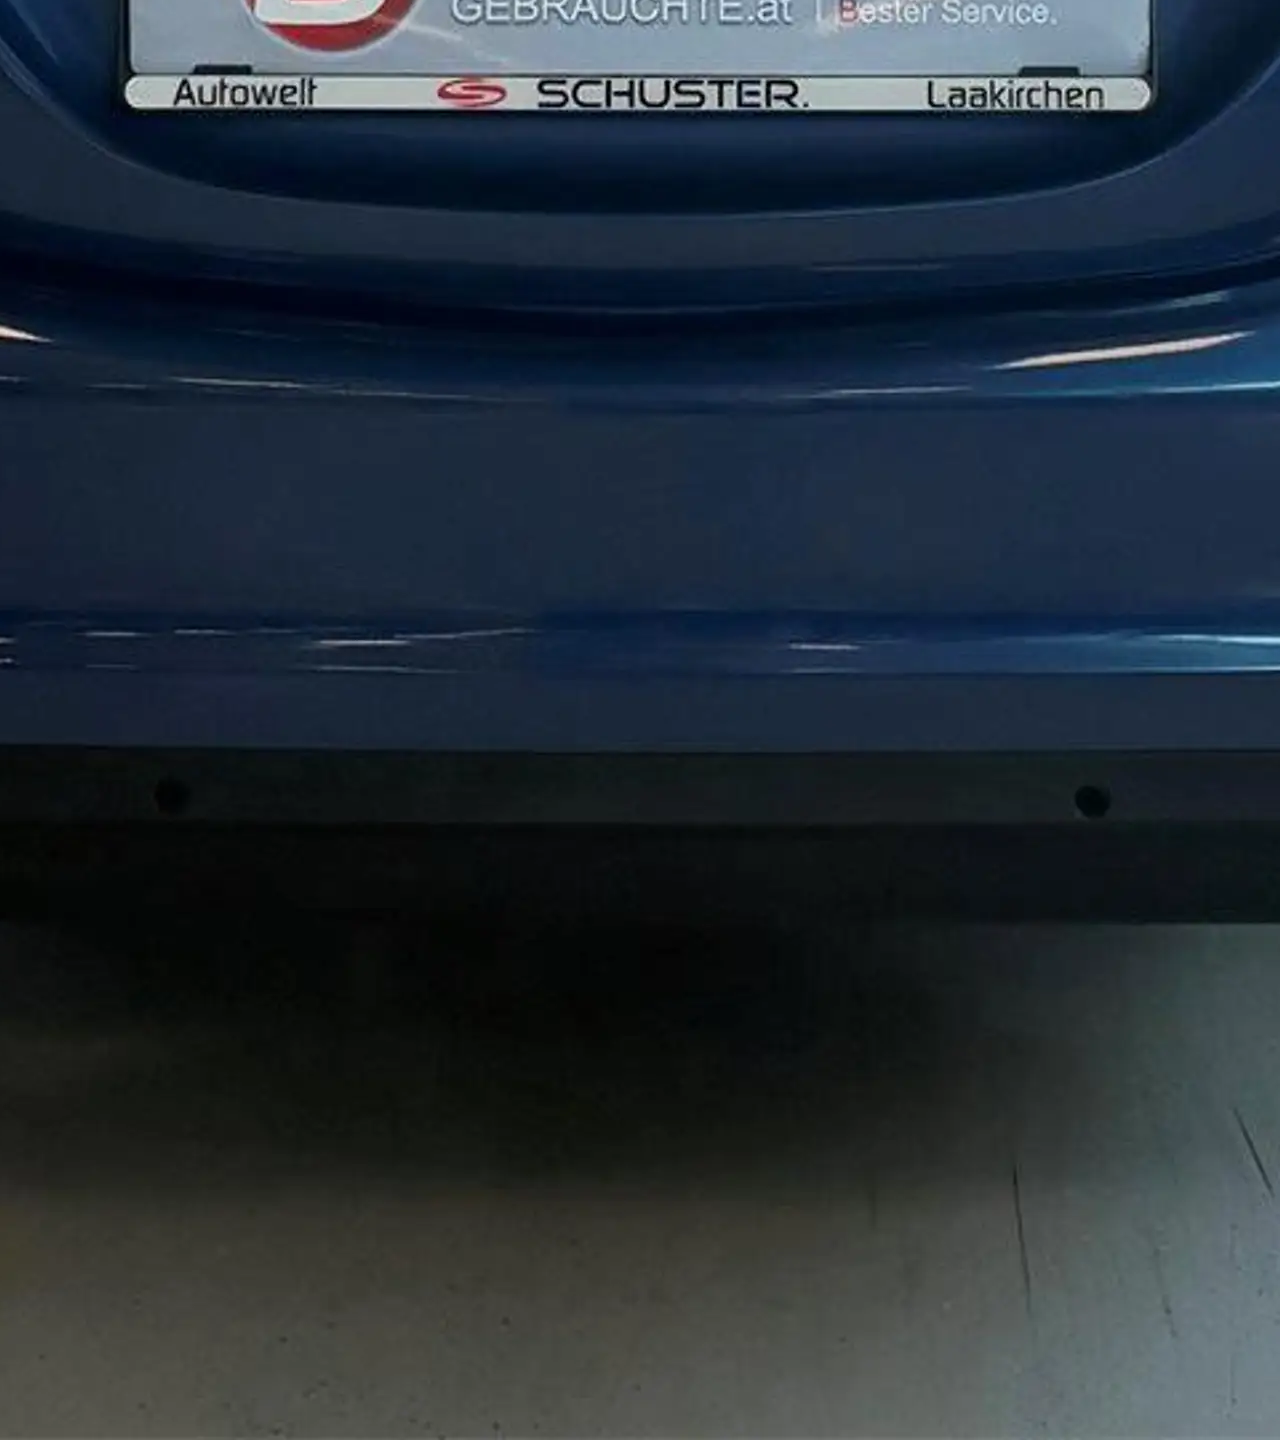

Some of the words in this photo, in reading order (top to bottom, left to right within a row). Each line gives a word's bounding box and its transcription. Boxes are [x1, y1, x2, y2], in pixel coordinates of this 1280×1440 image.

[173, 78, 318, 106] Autowelt
[536, 80, 810, 109] SCHUSTER.
[927, 80, 1104, 109] Laakirchen
